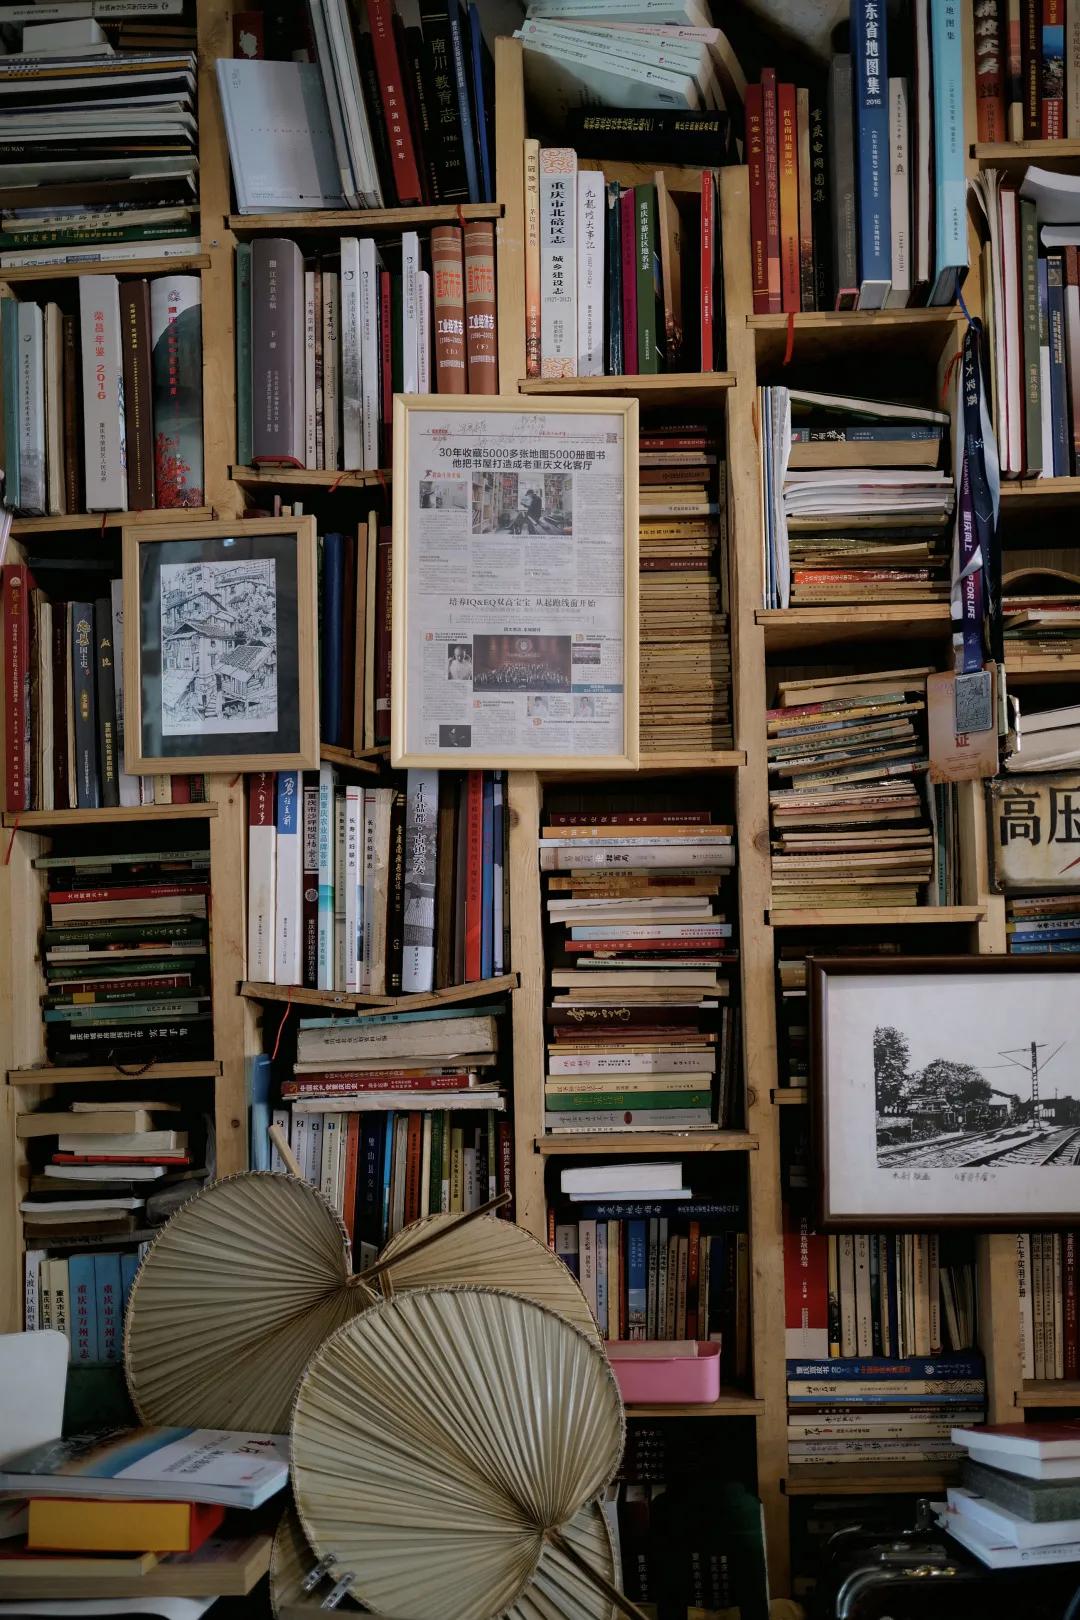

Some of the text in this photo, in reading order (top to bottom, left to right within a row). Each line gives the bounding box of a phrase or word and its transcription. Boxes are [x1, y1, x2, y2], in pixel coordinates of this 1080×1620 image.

[945, 0, 955, 41] 地图集
[863, 0, 881, 95] 东省地图集
[431, 38, 456, 124] 南川教育志
[864, 98, 882, 106] 2016
[550, 181, 566, 244] 重庆市北碚区志
[552, 255, 564, 295] 城乡建设志
[95, 311, 105, 357] 荣昌年鉴
[95, 363, 105, 400] 2016
[439, 447, 606, 460] 30年收藏5000多张地图5000册图书
[452, 458, 592, 471] 他把书屋打造成老重庆文化客厅
[963, 510, 973, 552] 重庆向上
[966, 582, 976, 602] FOR
[967, 601, 976, 620] LIFE
[999, 786, 1080, 847] 高压
[299, 1082, 358, 1093] 中国共产党重庆历史
[55, 1289, 66, 1331] 重庆市大渡口
[77, 1283, 90, 1360] 重庆市万州区志
[103, 1283, 116, 1360] 重庆市万州区志
